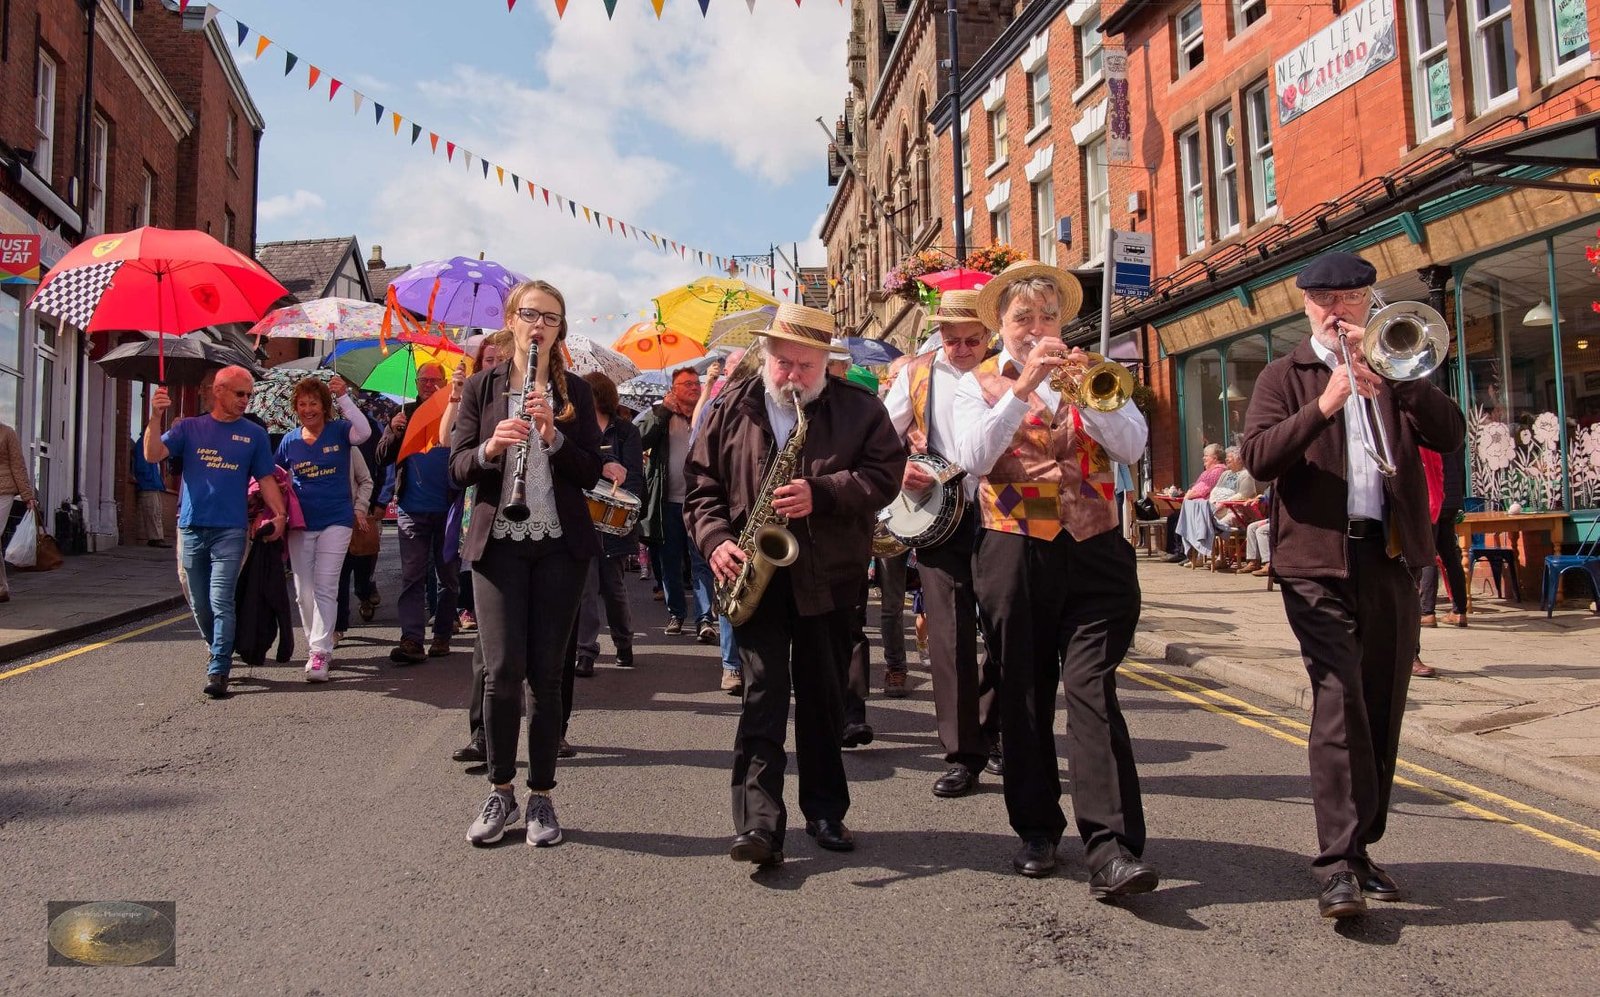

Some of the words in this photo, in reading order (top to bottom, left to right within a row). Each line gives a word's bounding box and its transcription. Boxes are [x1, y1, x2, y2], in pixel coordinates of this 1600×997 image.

[1278, 40, 1317, 86] NEXT
[1330, 0, 1391, 51] LEVEL
[1297, 41, 1368, 96] Tattoo
[0, 239, 32, 251] UST
[2, 252, 32, 263] EAT
[200, 455, 223, 463] Laugh
